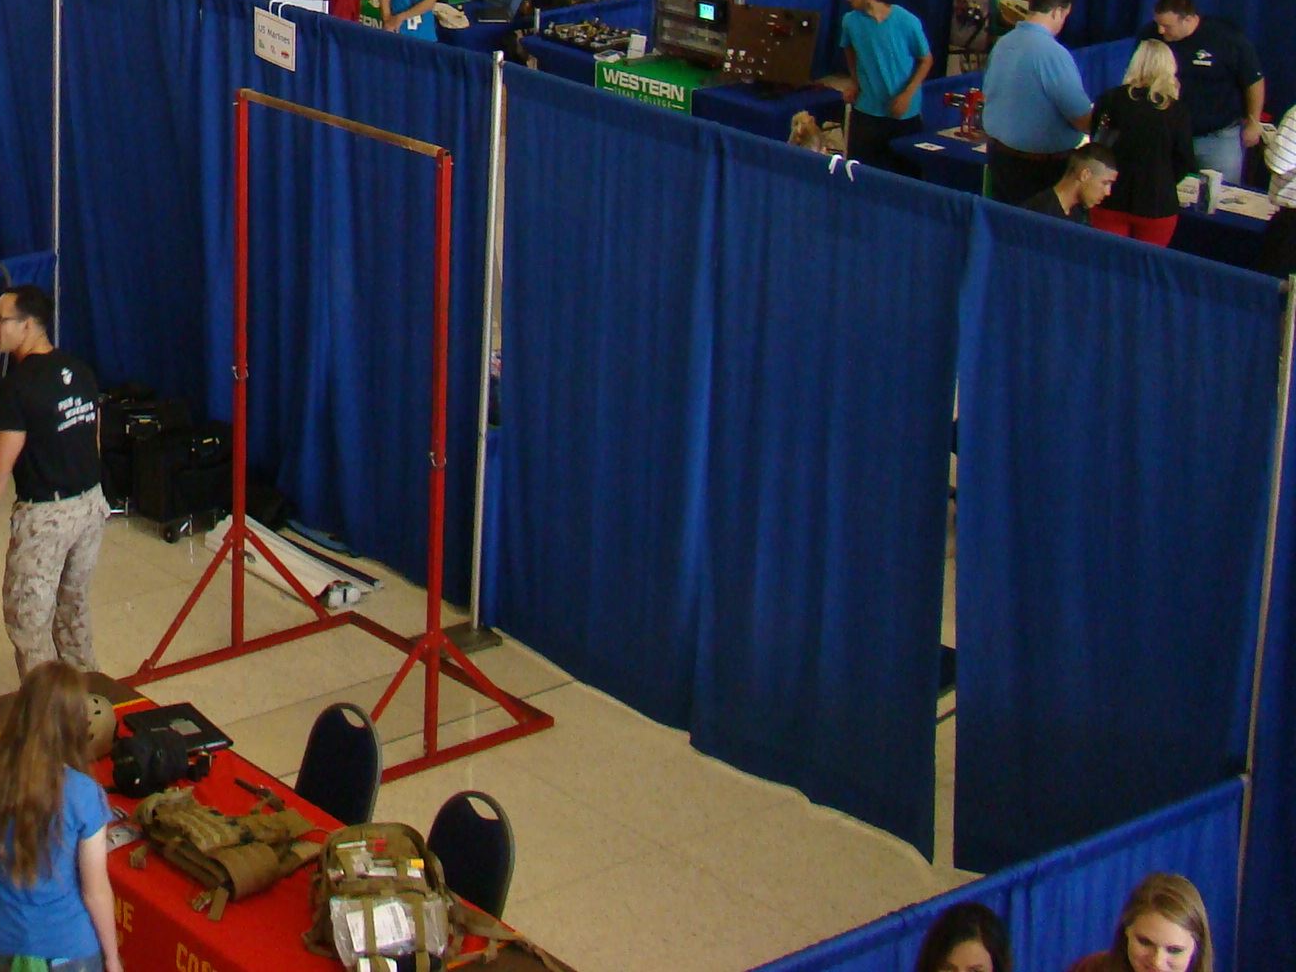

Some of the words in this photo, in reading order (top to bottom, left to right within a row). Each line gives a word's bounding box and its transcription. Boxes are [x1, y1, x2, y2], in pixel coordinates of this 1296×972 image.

[267, 28, 290, 45] Marines
[603, 67, 684, 102] WESTERN
[639, 94, 672, 108] COLLEGE
